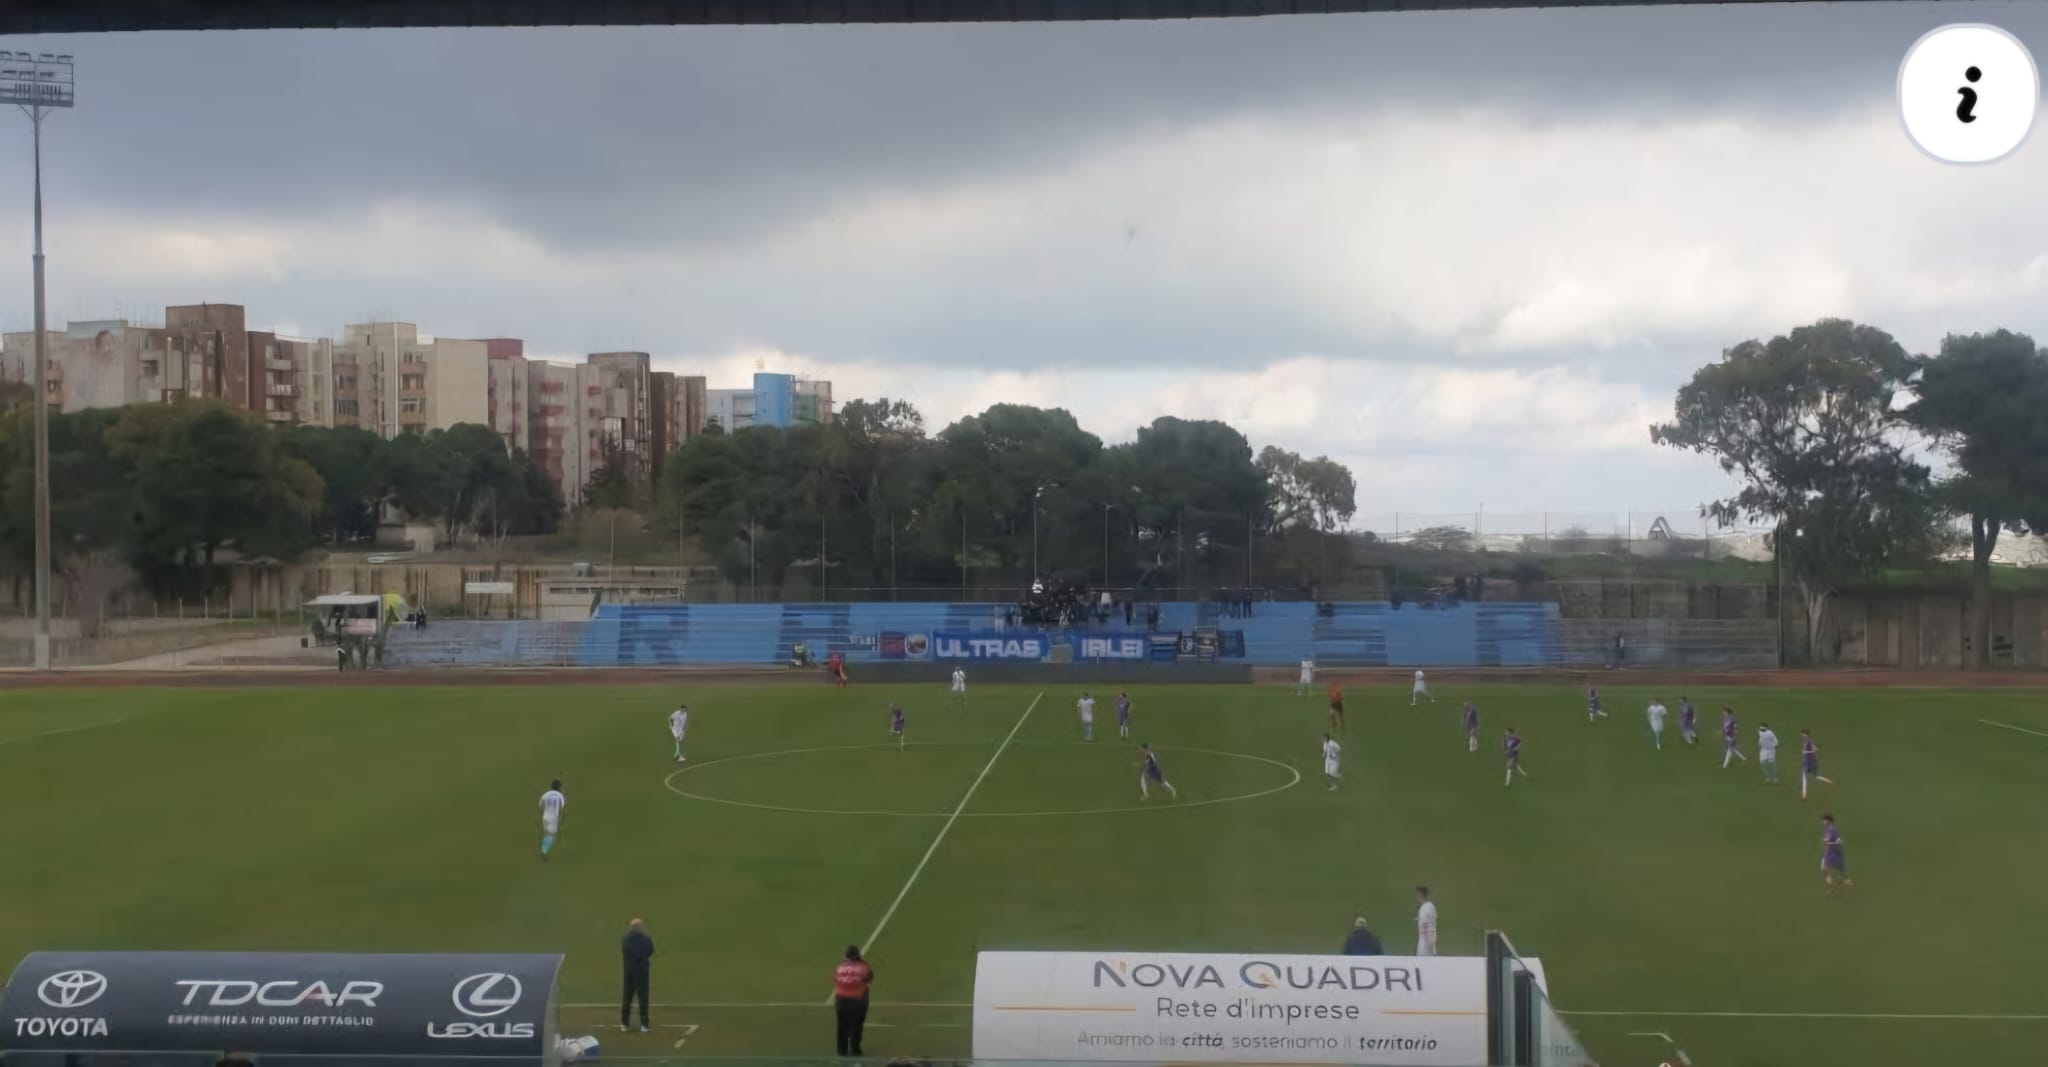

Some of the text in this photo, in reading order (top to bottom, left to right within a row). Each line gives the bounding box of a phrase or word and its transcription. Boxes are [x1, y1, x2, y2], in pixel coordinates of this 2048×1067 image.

[935, 639, 1040, 658] ULTRAS
[1093, 959, 1423, 991] NOVA QUADRI
[175, 980, 384, 1007] TDCAR
[1156, 997, 1360, 1025] Rete d'imprese
[14, 1017, 108, 1037] TOYOTA
[426, 1021, 535, 1038] LEXUS
[1077, 1031, 1154, 1047] Amiamo
[1231, 1035, 1338, 1049] sosteniamo
[1359, 1035, 1437, 1050] territorio
